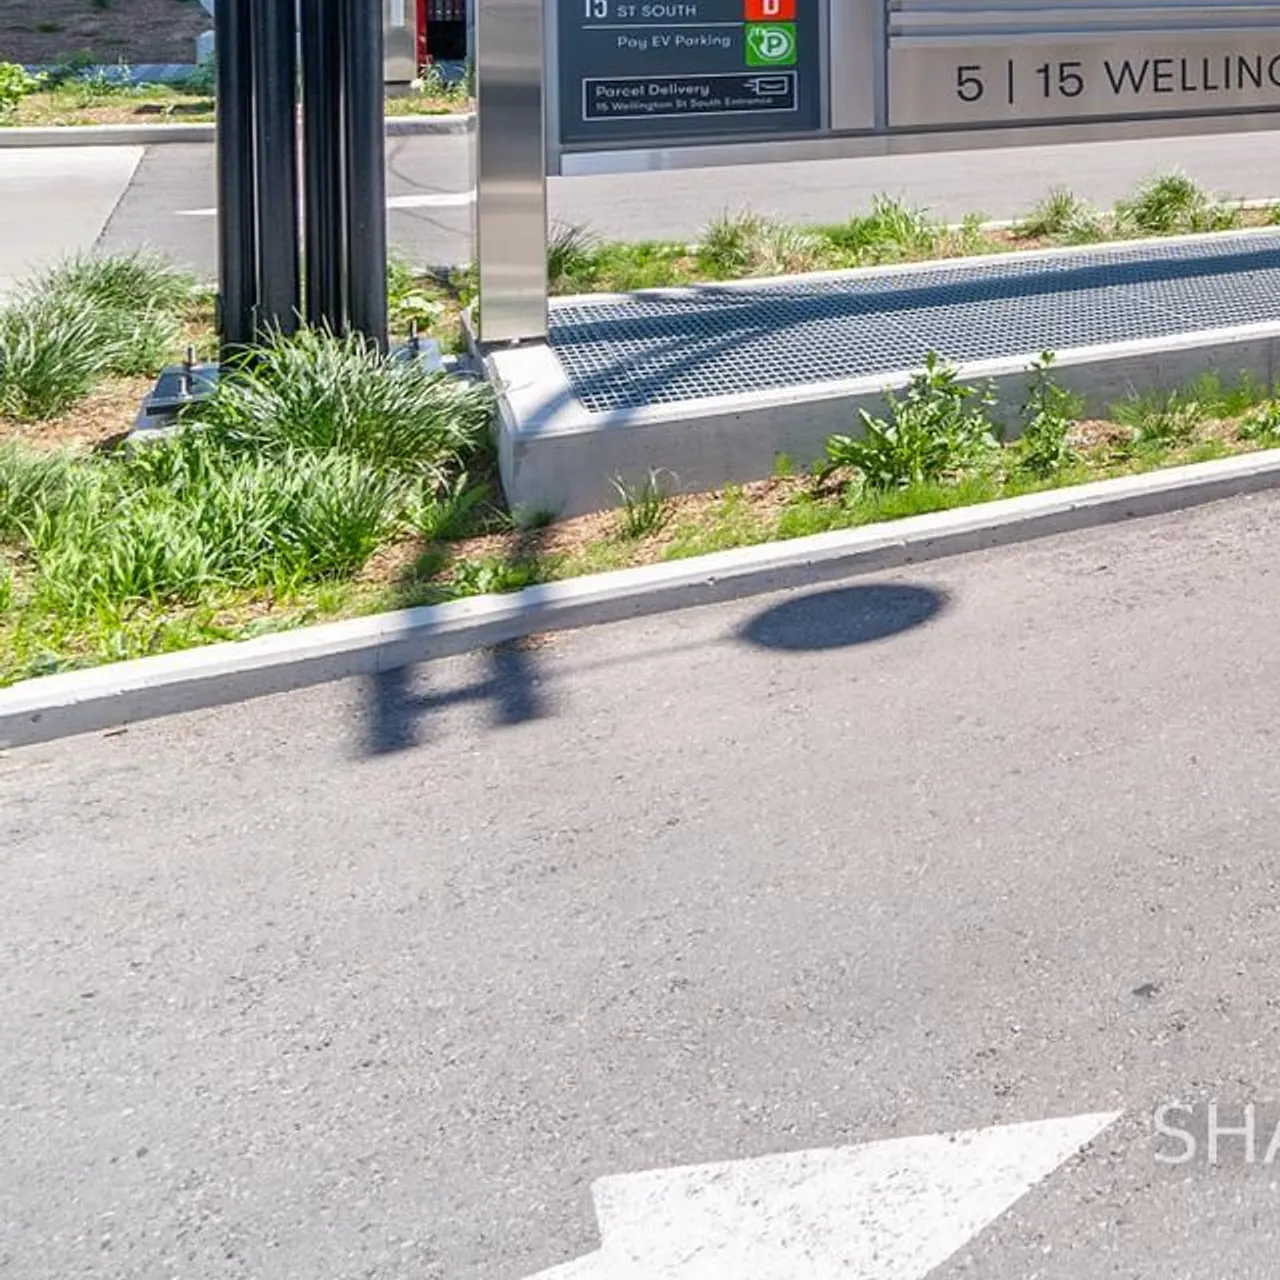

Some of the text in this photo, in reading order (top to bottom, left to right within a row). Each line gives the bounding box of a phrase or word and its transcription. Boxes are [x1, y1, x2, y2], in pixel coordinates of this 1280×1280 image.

[616, 4, 698, 18] ST SOUTH
[617, 34, 732, 51] Pay EV Parking
[957, 66, 984, 102] 5
[1035, 62, 1085, 98] 15
[595, 83, 710, 98] Parcel Delivery
[612, 100, 673, 113] Wellington
[690, 98, 722, 109] South
